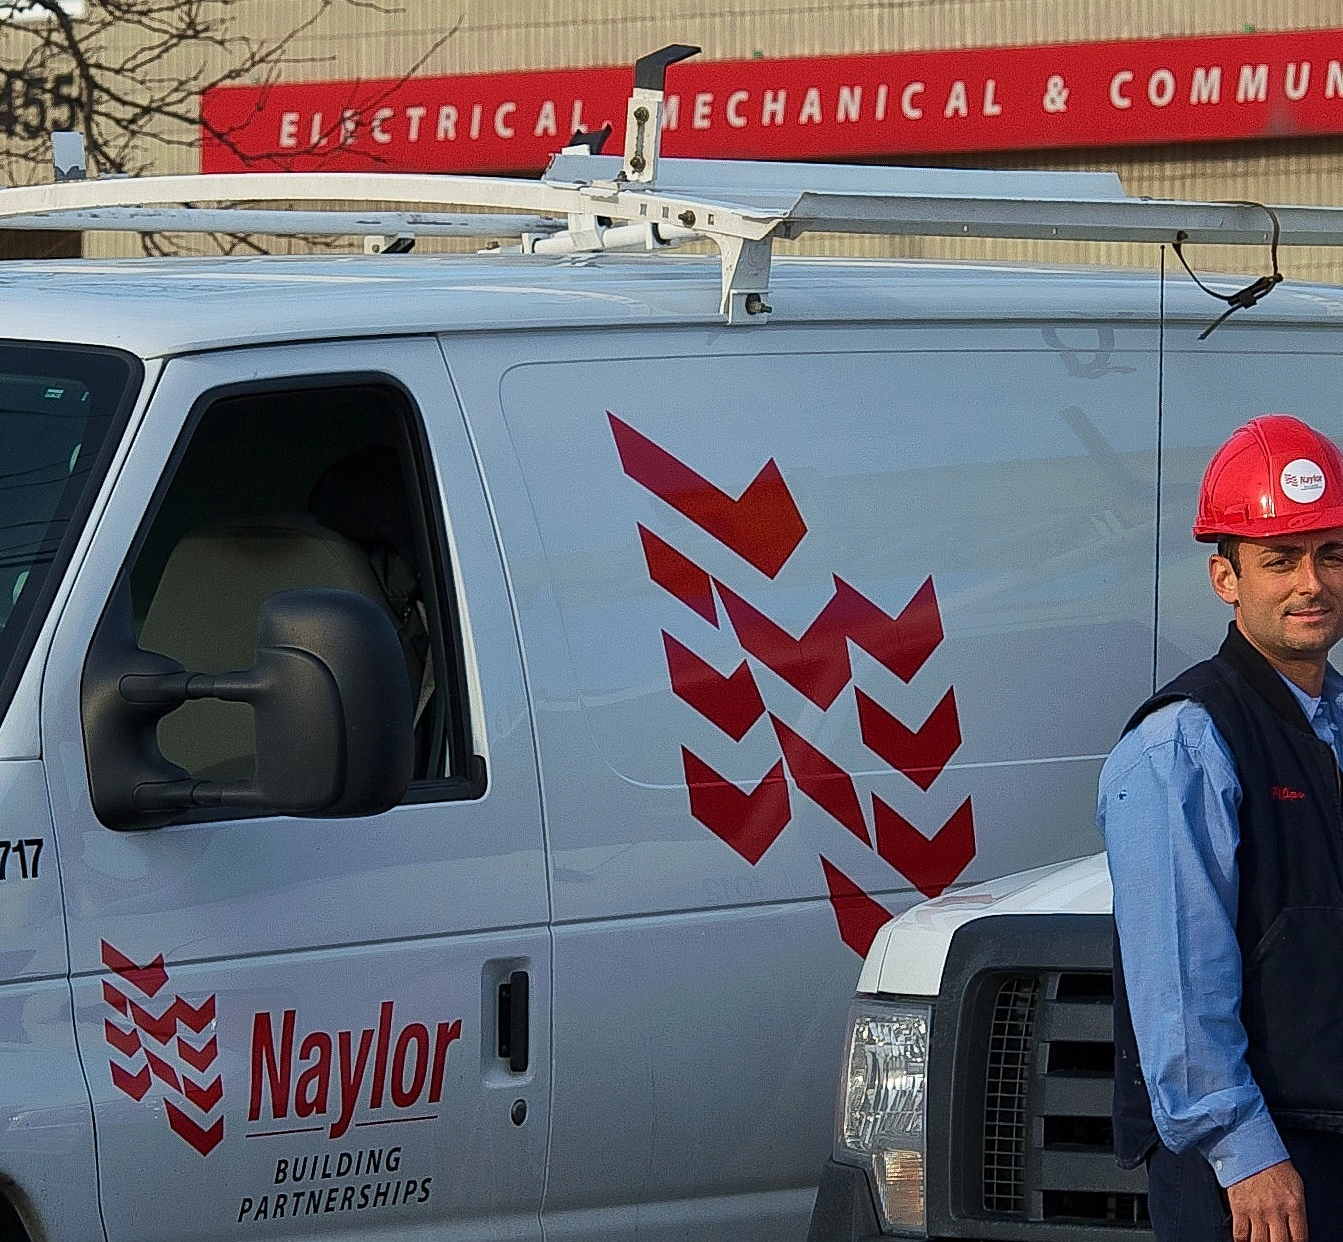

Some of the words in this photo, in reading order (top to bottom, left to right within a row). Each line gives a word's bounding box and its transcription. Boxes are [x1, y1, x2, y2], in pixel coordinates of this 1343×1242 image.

[1042, 74, 1070, 113] &
[248, 1000, 463, 1140] Naylor
[273, 1147, 402, 1185] BUILDING
[236, 1177, 433, 1223] PARTNERSHIPS
